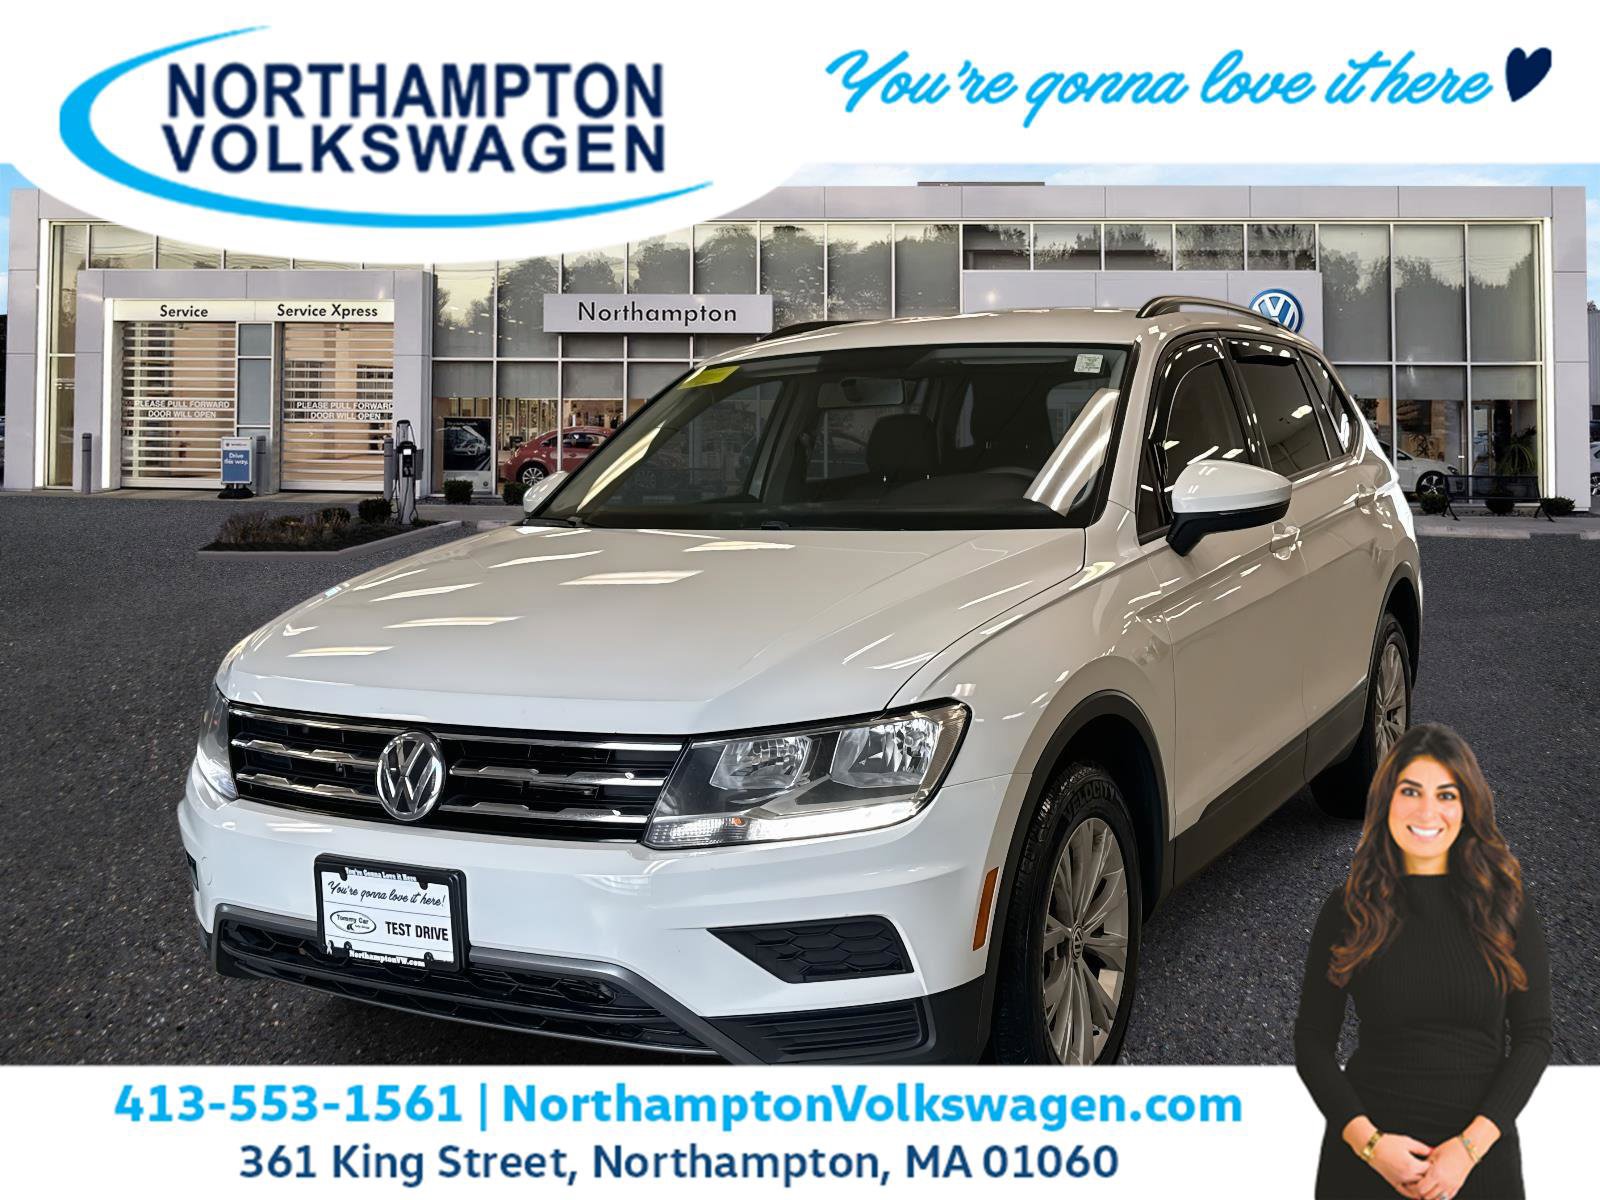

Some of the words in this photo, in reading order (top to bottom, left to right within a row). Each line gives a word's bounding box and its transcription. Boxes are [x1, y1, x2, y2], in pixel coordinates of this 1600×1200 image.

[159, 304, 208, 317] Service
[277, 303, 327, 317] Service
[331, 303, 378, 319] Xpress
[578, 301, 737, 327] Northampton
[134, 400, 166, 408] PLEASE
[167, 400, 188, 408] PULL
[189, 400, 230, 409] FORWARD
[296, 401, 328, 409] PLEASE
[330, 401, 352, 409] PULL
[353, 402, 395, 410] FORWARD
[358, 412, 381, 420] OPEN
[328, 880, 359, 896] You're
[360, 888, 388, 902] gonna
[388, 889, 409, 903] love
[410, 893, 422, 904] it
[420, 894, 446, 907] here!
[385, 920, 412, 937] TEST
[415, 924, 449, 942] DRIVE
[348, 949, 426, 968] NorthamptonVW.com
